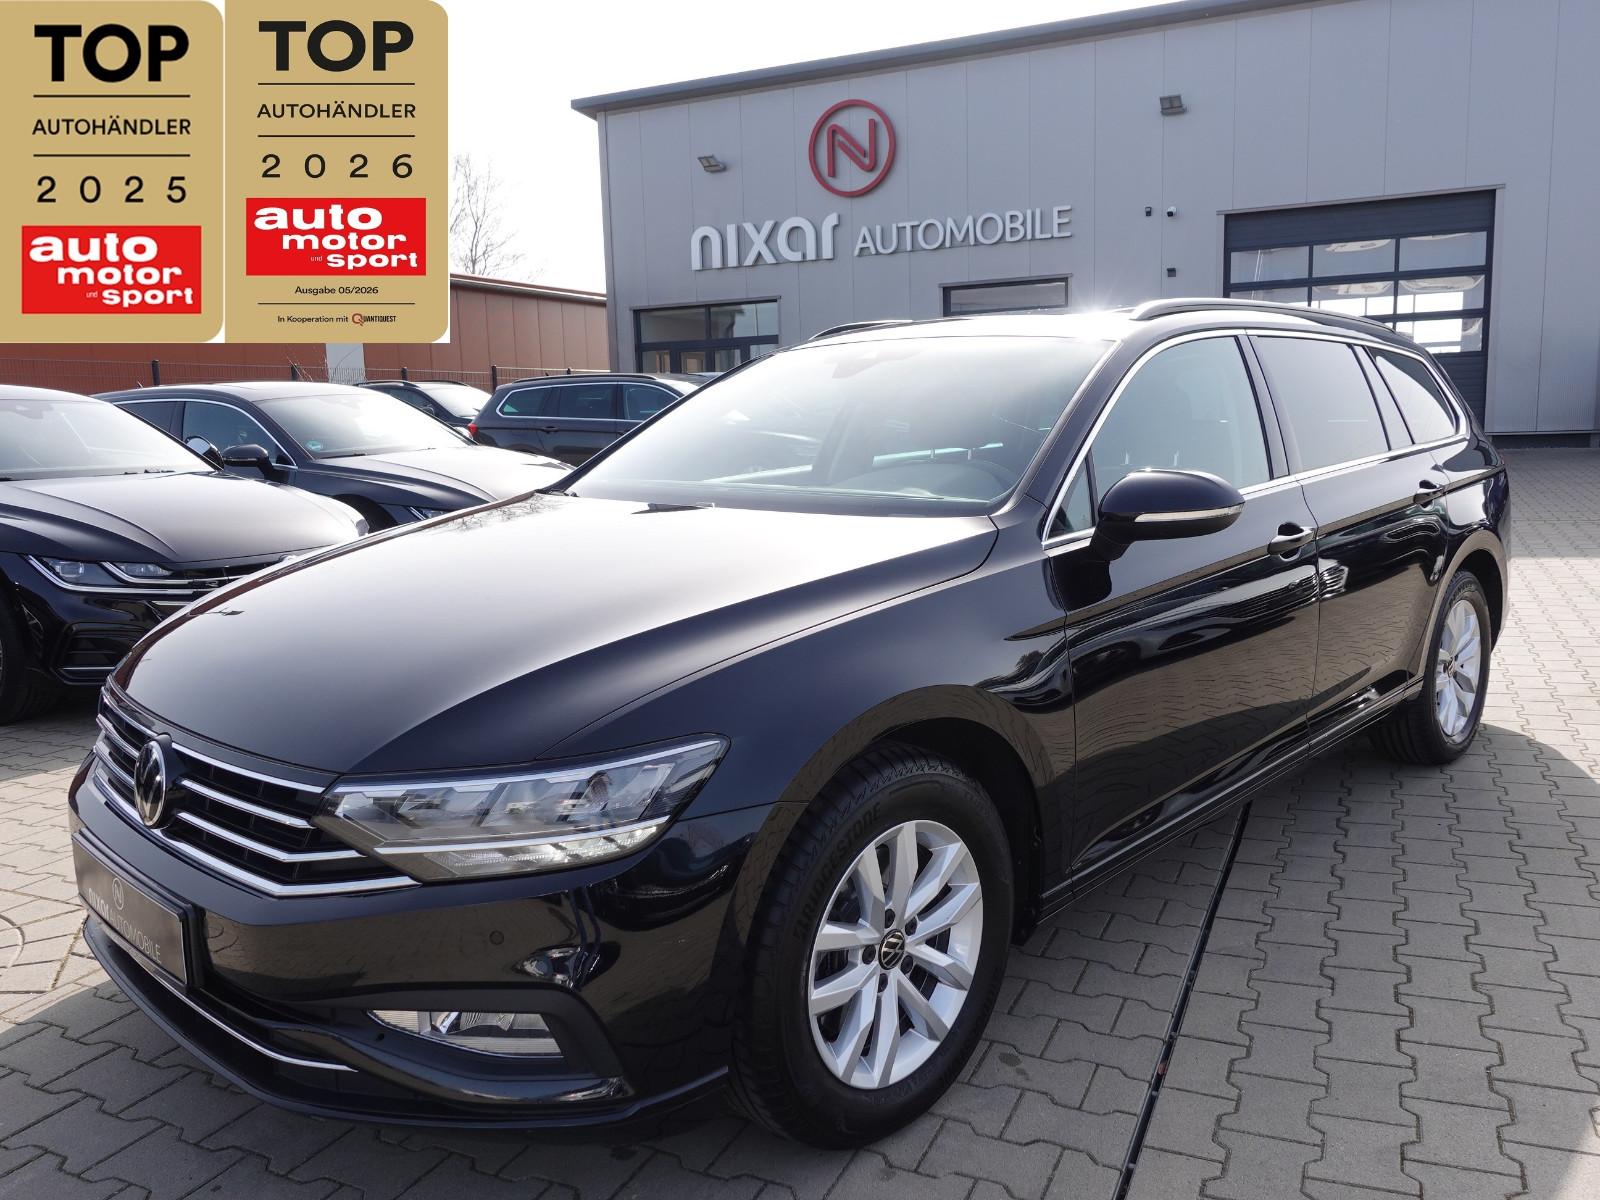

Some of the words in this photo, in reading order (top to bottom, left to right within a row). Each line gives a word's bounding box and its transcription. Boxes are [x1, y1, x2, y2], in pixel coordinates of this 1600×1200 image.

[690, 212, 840, 270] nixar
[853, 205, 1072, 256] AUTOMOBILE
[109, 909, 162, 964] AUTOMOBILE
